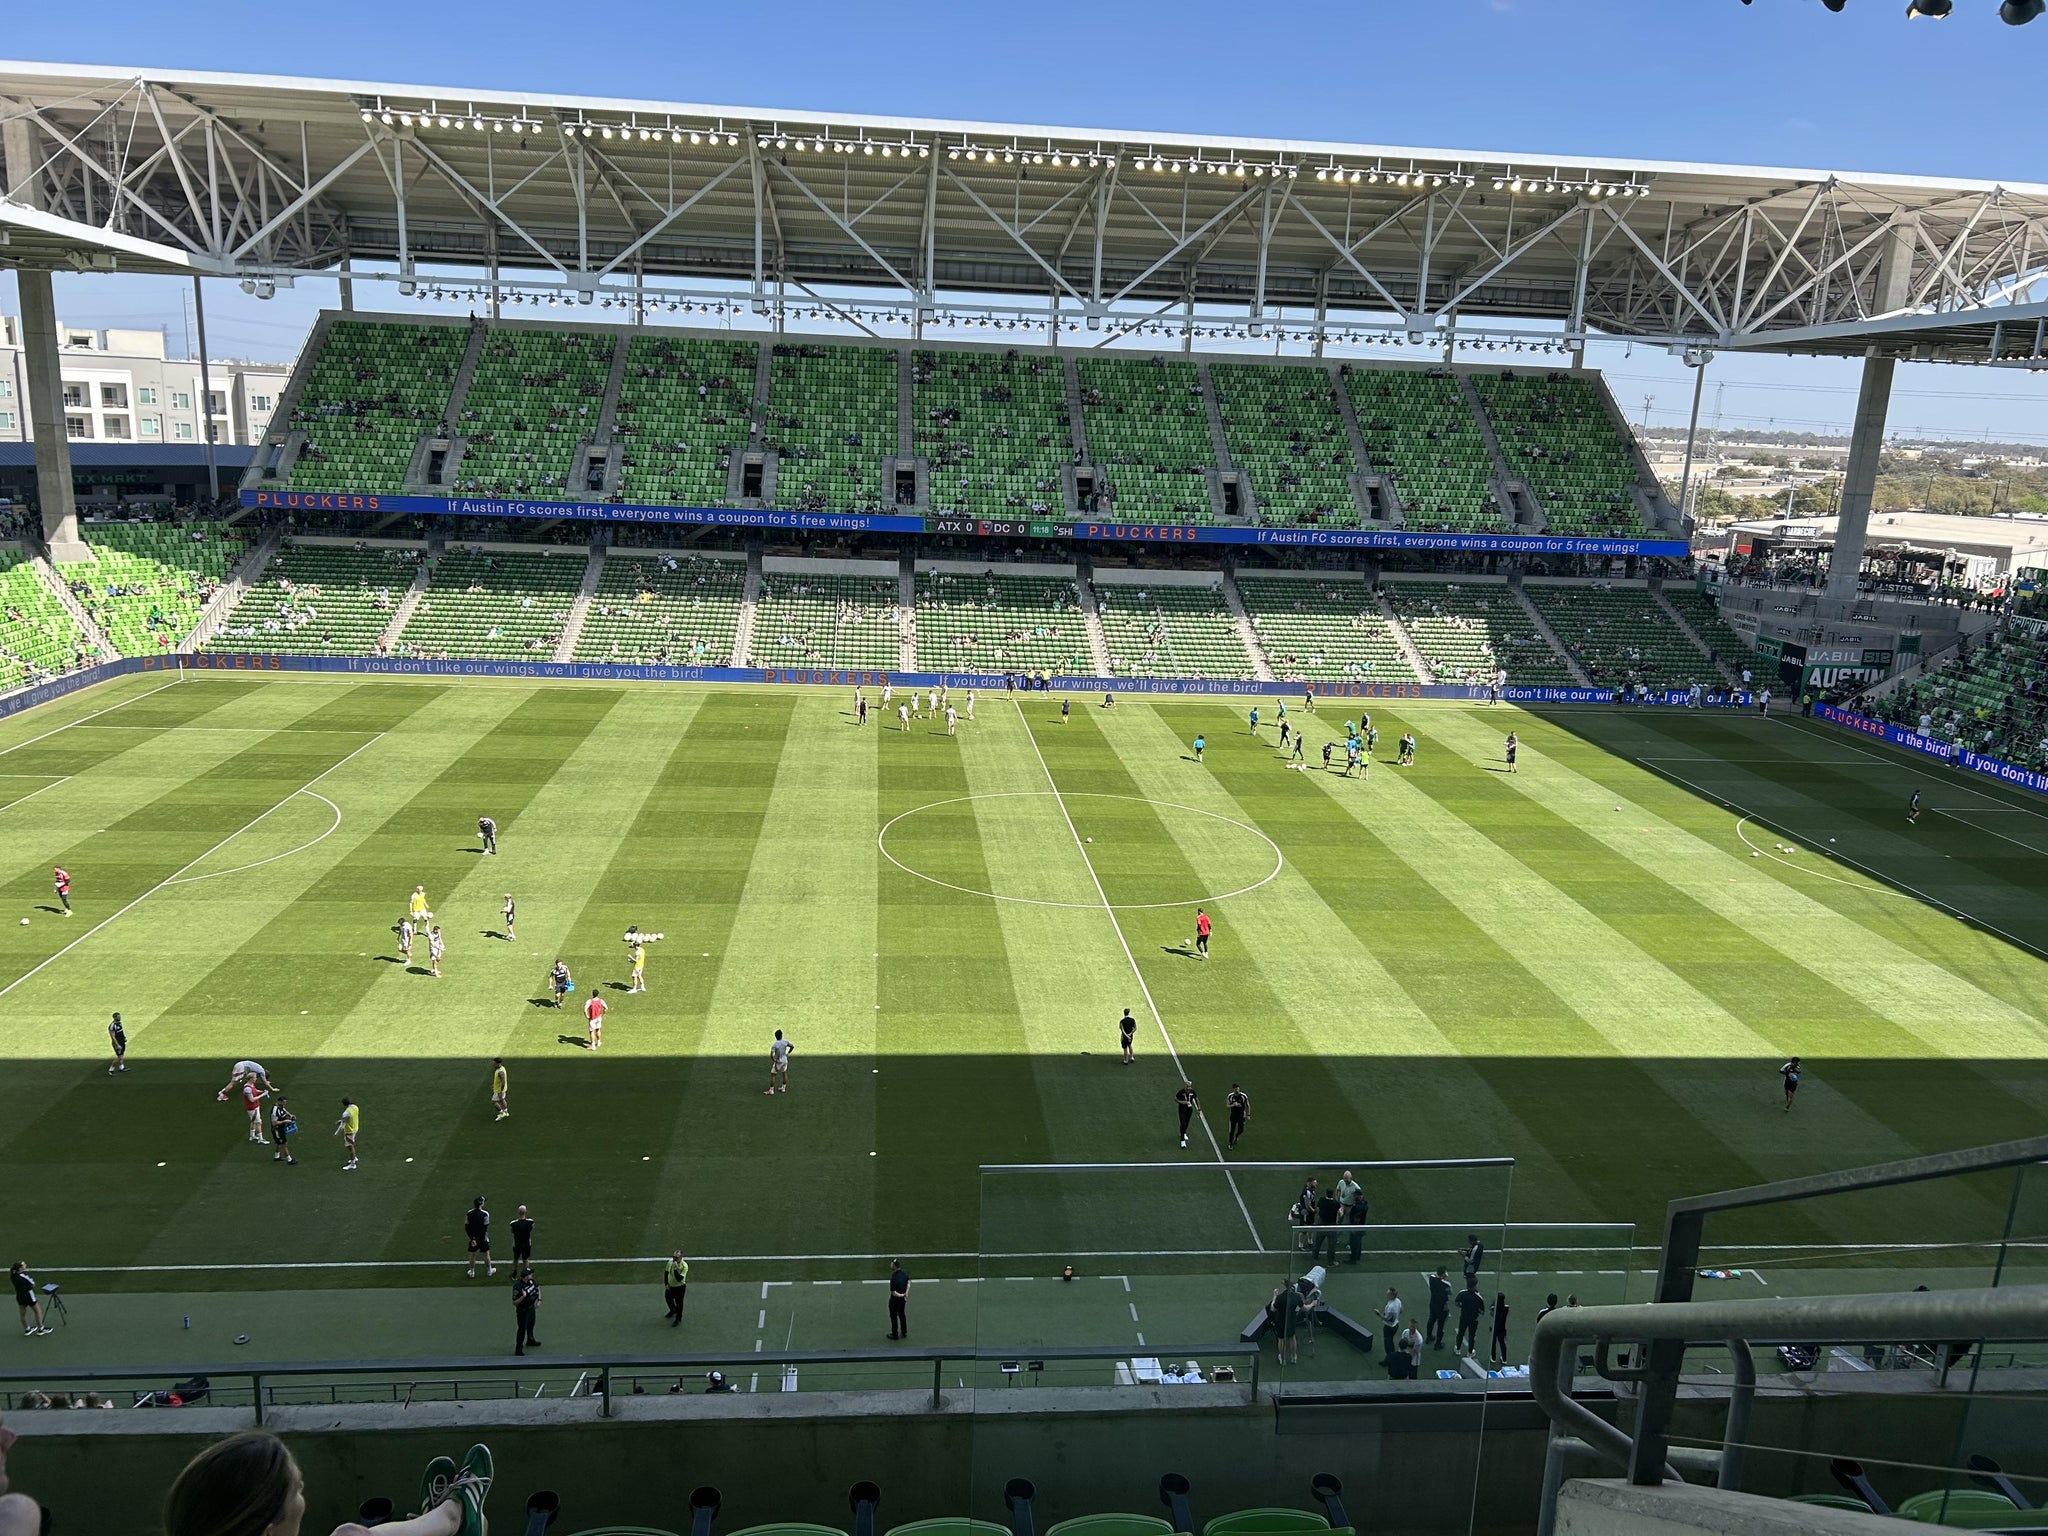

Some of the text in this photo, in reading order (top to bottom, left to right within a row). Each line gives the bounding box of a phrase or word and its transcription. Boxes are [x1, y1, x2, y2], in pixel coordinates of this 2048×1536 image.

[257, 493, 380, 509] PLUCKERS
[448, 501, 457, 511] If
[462, 502, 503, 513] Austin
[508, 504, 525, 514] FC
[530, 507, 573, 516] scores
[577, 506, 607, 519] first,
[611, 509, 670, 521] everyone
[674, 511, 703, 521] wins
[718, 513, 764, 524] coupon
[768, 514, 786, 524] for
[790, 515, 797, 525] 5
[801, 516, 826, 526] free
[829, 517, 870, 530] wings!
[937, 521, 973, 532] ATX 0
[994, 524, 1025, 534] DC 0
[1088, 526, 1197, 540] PLUCKERS
[1257, 531, 1267, 541] If
[1270, 532, 1308, 543] Austin
[1311, 533, 1327, 543] FC
[1330, 535, 1370, 544] scores
[1373, 535, 1401, 547] first,
[1404, 538, 1458, 548] everyone
[1461, 538, 1487, 548] wins
[1500, 540, 1543, 551] coupon
[1546, 541, 1563, 550] for
[1566, 542, 1573, 551] 5
[1576, 542, 1599, 551] free
[1602, 543, 1639, 554] wings!
[1757, 643, 1779, 657] ATX
[1808, 651, 1860, 662] JABIL
[143, 656, 281, 670] PLUCKERS
[1781, 654, 1804, 667] JABIL
[348, 659, 704, 679] If you don't like our wings, we'll give you the bird!
[764, 670, 888, 685] PLUCKERS
[939, 675, 948, 685] If
[953, 678, 977, 687] you
[1019, 677, 1042, 688] lie
[1071, 679, 1113, 691] wings,
[1117, 680, 1147, 691] we'll
[1151, 681, 1178, 693] give
[1182, 683, 1205, 694] you
[1208, 682, 1224, 692] the
[1233, 682, 1263, 693] bird!
[31, 688, 49, 705] give
[51, 683, 66, 698] you
[67, 677, 81, 690] the
[1468, 686, 1479, 697] If
[1482, 689, 1504, 699] yu
[1508, 688, 1541, 699] don't
[1545, 688, 1567, 699] like
[1570, 691, 1592, 700] our
[1824, 707, 1885, 736] PLUCKERS
[1905, 732, 1924, 749] the
[1925, 738, 1951, 758] bird!
[1965, 752, 1975, 765] If
[1975, 757, 1998, 773] you
[2002, 765, 2034, 785] don't
